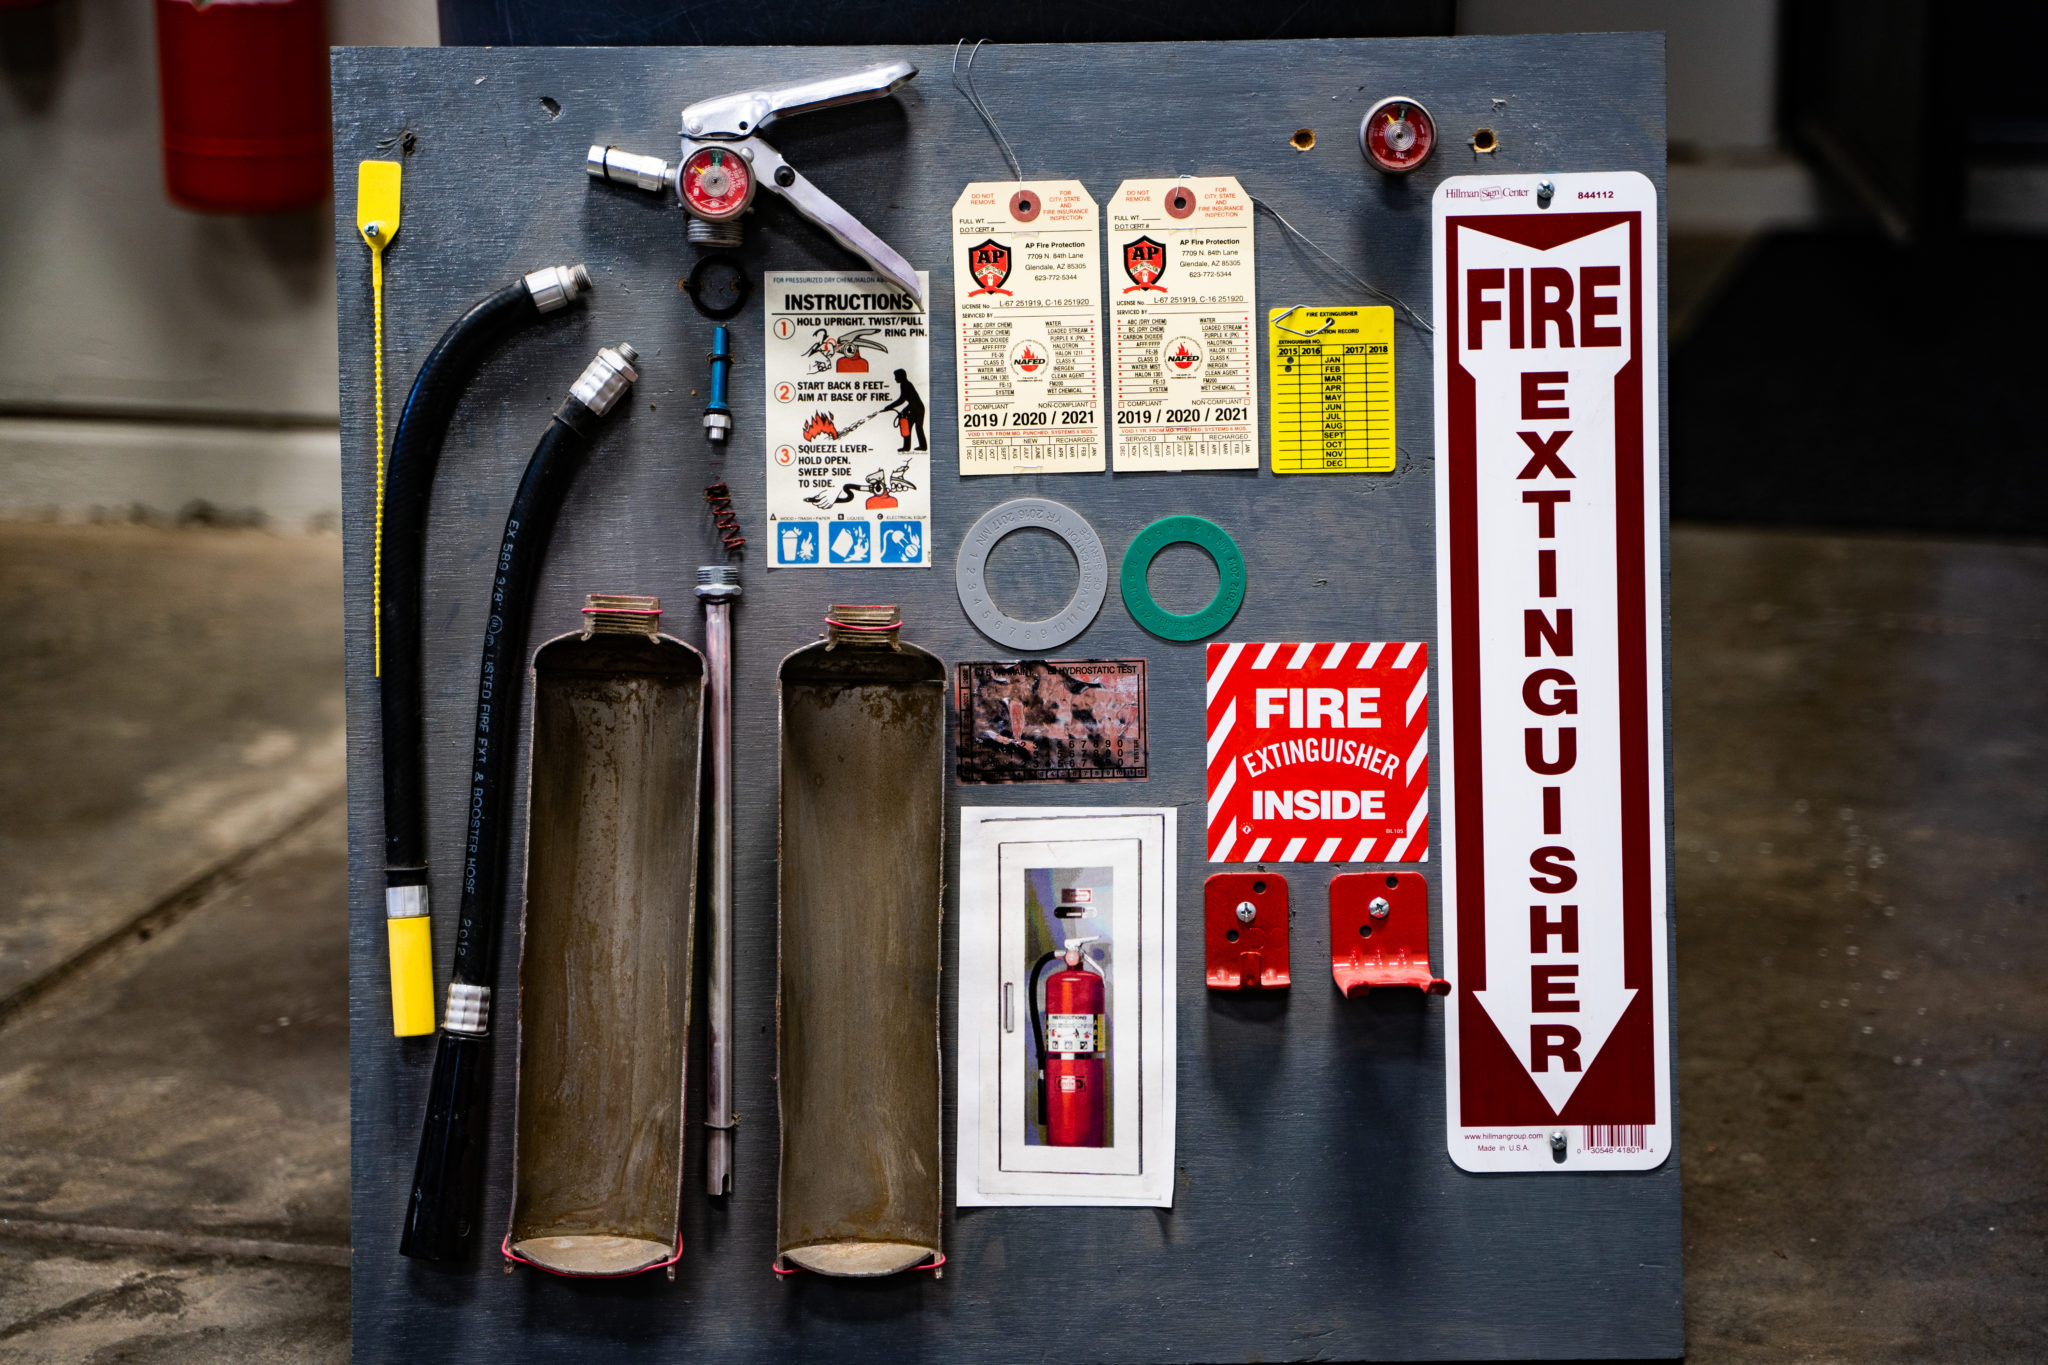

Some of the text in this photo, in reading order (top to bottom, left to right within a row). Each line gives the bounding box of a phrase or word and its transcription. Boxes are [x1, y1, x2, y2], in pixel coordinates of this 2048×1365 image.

[1445, 187, 1529, 199] Hillman Sign Center
[1577, 191, 1614, 200] 844112
[977, 250, 1004, 264] AP
[1132, 247, 1159, 261] AP
[785, 293, 913, 311] INSTRUCTIONS
[1467, 265, 1622, 350] FIRE
[797, 317, 923, 326] HOLD UPRIGHT. TWIST/PULL
[781, 321, 786, 337] 1
[884, 329, 927, 337] RING PIN.
[779, 385, 789, 400] 2
[797, 382, 824, 390] START
[828, 381, 852, 390] BACK
[854, 381, 860, 390] 8
[797, 392, 893, 402] AIM AT BASE OF FIRE.
[964, 413, 998, 428] 2019
[1012, 412, 1047, 426] 2020
[1061, 410, 1094, 425] 2021
[1117, 410, 1152, 424] 2019
[1166, 409, 1200, 423] 2020
[1215, 407, 1247, 421] 2021
[780, 448, 790, 464] 3
[798, 445, 837, 454] SQUEEZE
[798, 456, 851, 465] HOLD OPEN.
[798, 468, 852, 476] SWEEP SIDE
[798, 479, 836, 488] TO SIDE.
[506, 519, 520, 538] EX
[500, 544, 514, 571] 589
[481, 652, 495, 700] LISTED
[1060, 666, 1137, 675] HYDROSTATIC TEST
[1255, 687, 1382, 729] FIRE
[1516, 371, 1582, 1073] EXTINGUISHER
[1242, 737, 1401, 780] EXTINGUISHER
[474, 771, 484, 782] &
[1252, 789, 1386, 821] INSIDE
[468, 787, 484, 854] BOOSTER
[1464, 1132, 1543, 1142] www.hillmangroup.com
[1617, 1146, 1640, 1154] 41801
